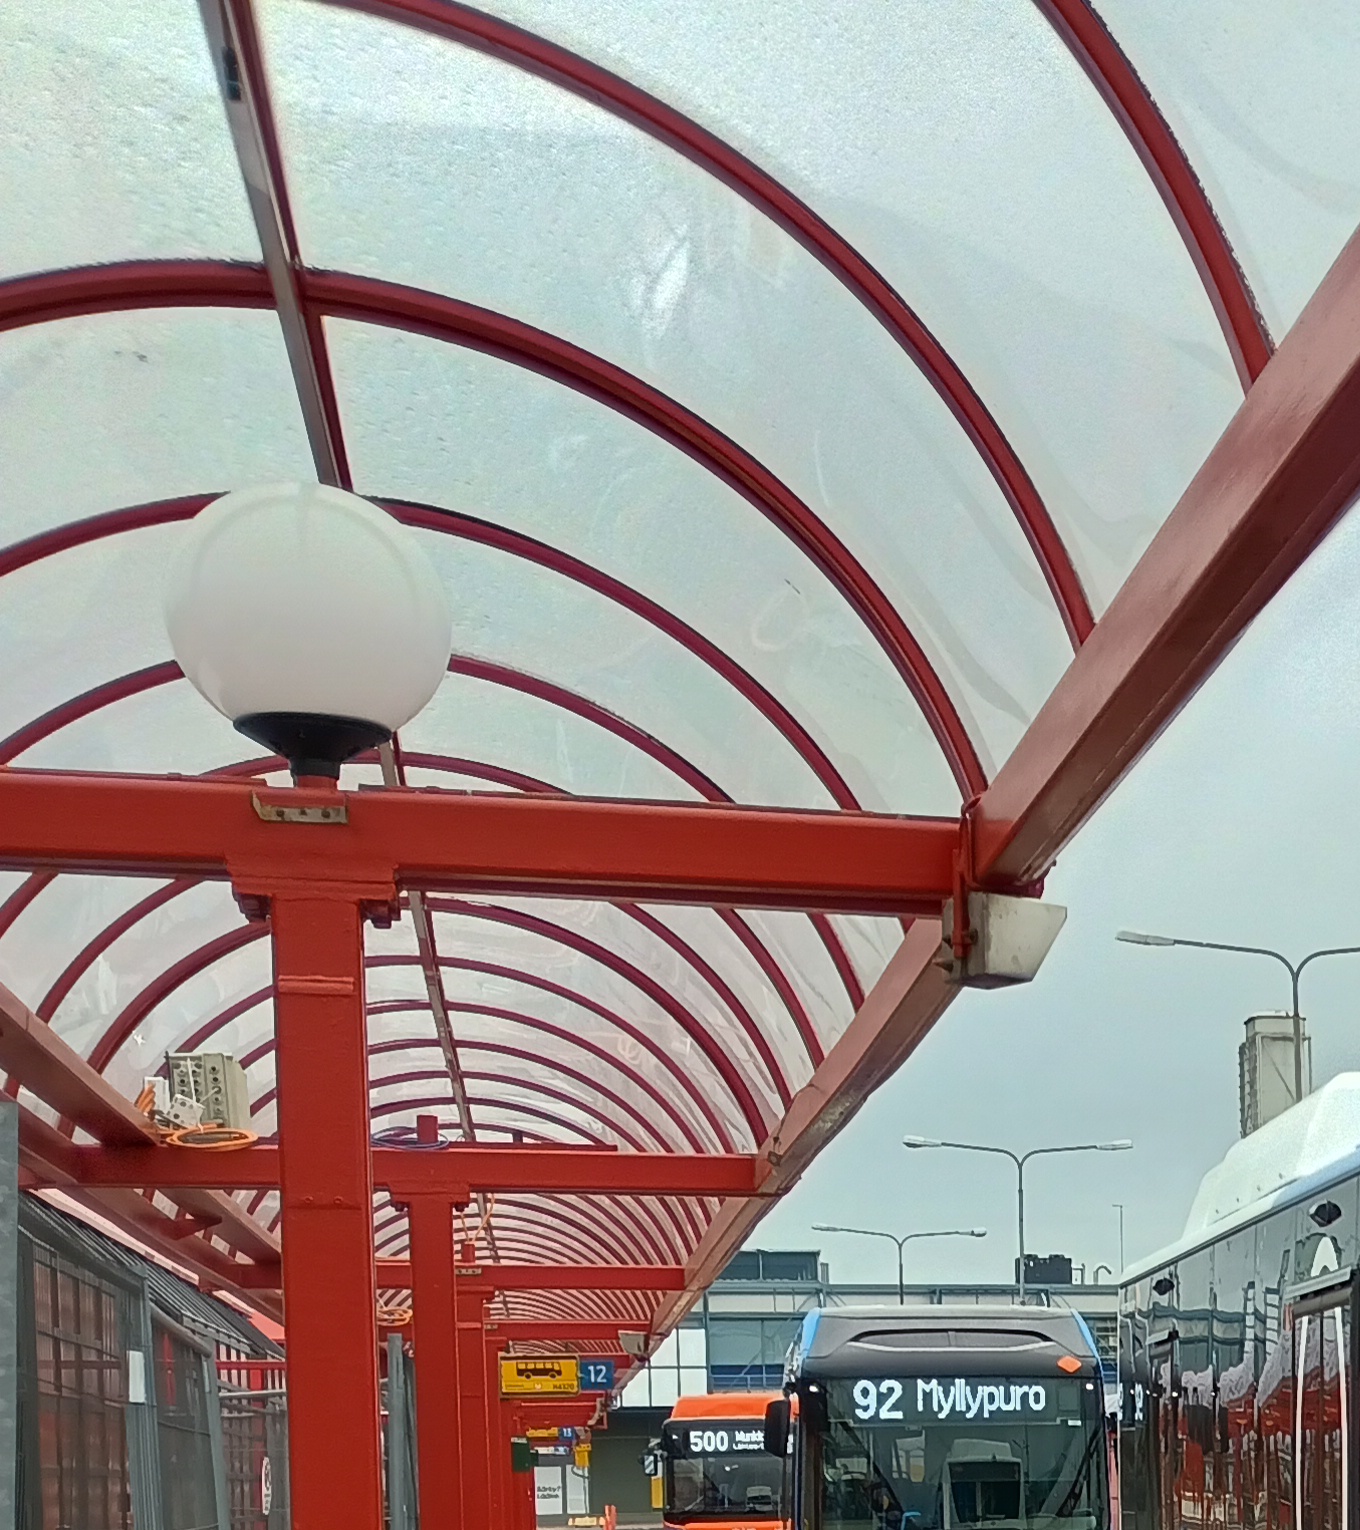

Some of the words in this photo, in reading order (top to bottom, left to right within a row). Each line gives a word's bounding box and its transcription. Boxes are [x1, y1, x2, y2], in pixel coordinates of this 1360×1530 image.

[587, 1365, 607, 1383] 12
[853, 1379, 904, 1420] 92
[916, 1378, 1046, 1420] Myllypuro
[562, 1427, 572, 1438] 13
[689, 1430, 729, 1452] 500
